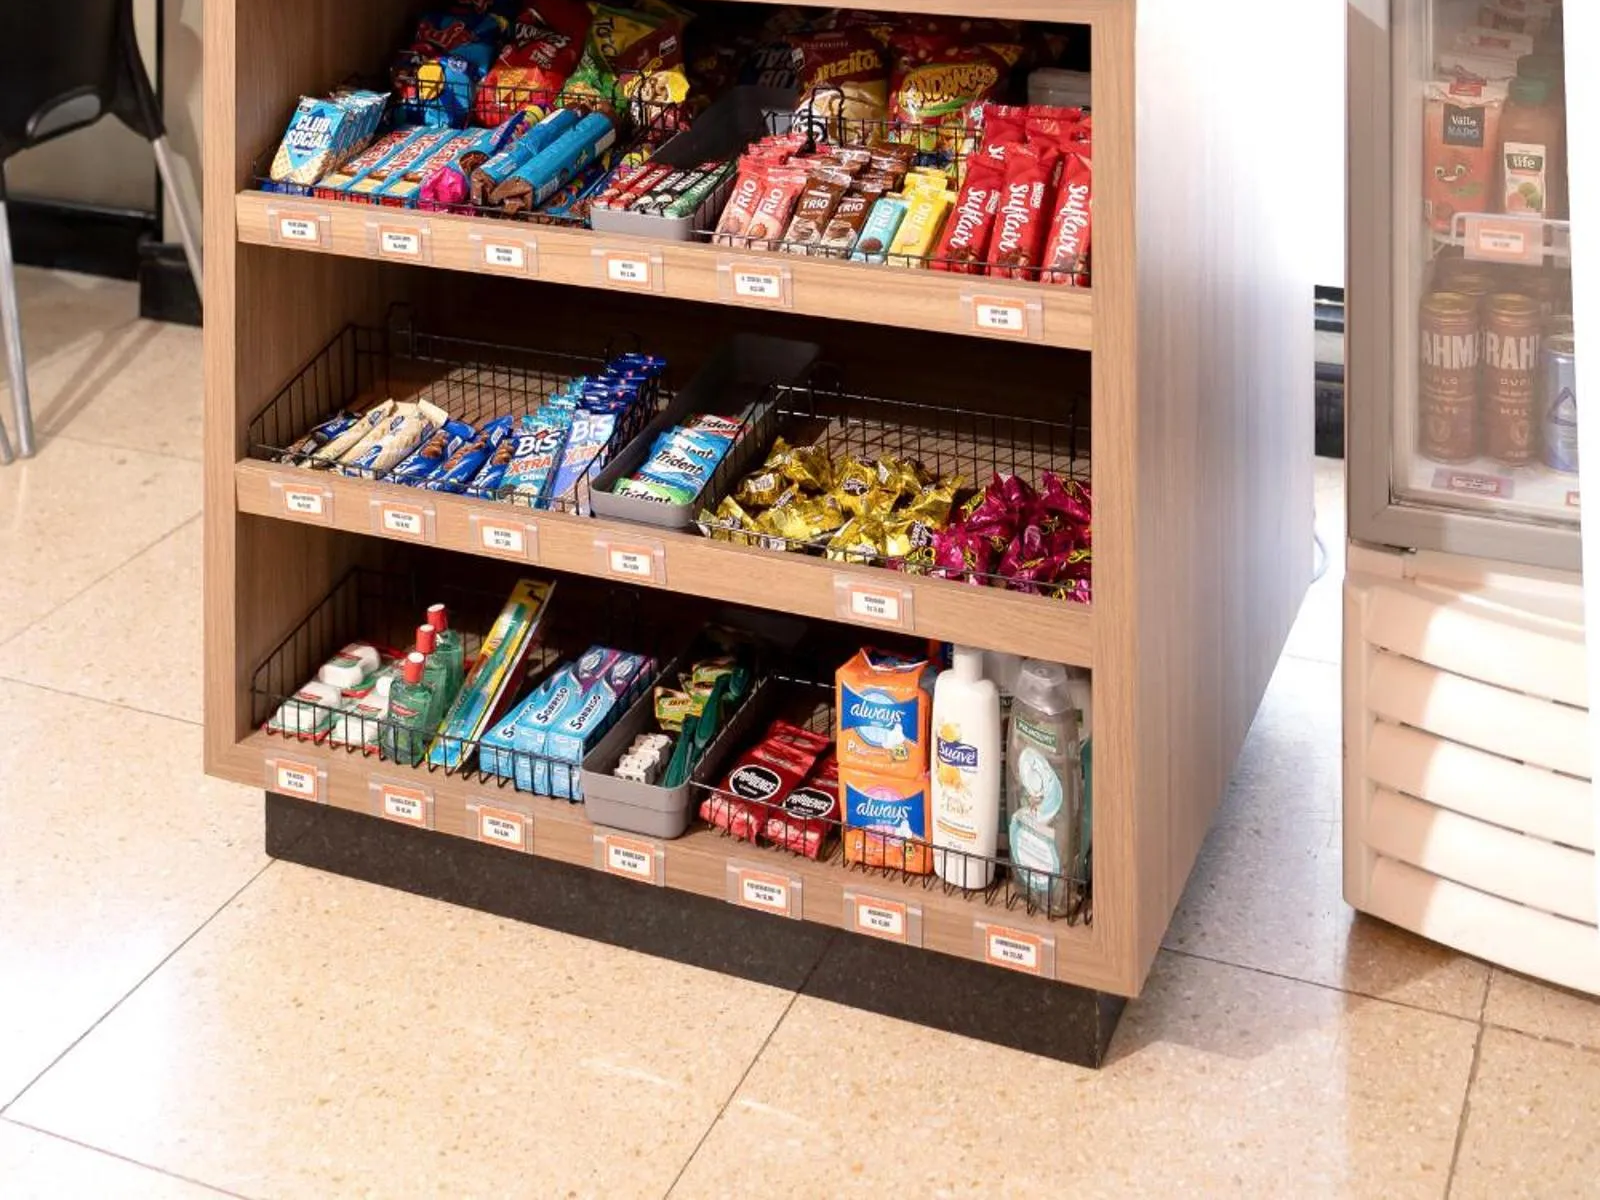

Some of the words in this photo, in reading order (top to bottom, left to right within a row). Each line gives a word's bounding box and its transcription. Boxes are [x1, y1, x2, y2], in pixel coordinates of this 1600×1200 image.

[295, 115, 332, 132] CLUB
[286, 128, 331, 148] SOCIAL
[999, 182, 1030, 253] Suflair
[514, 430, 562, 458] BIS
[655, 449, 705, 475] Trident
[850, 701, 907, 728] always
[938, 741, 976, 765] Suave
[855, 798, 912, 826] always
